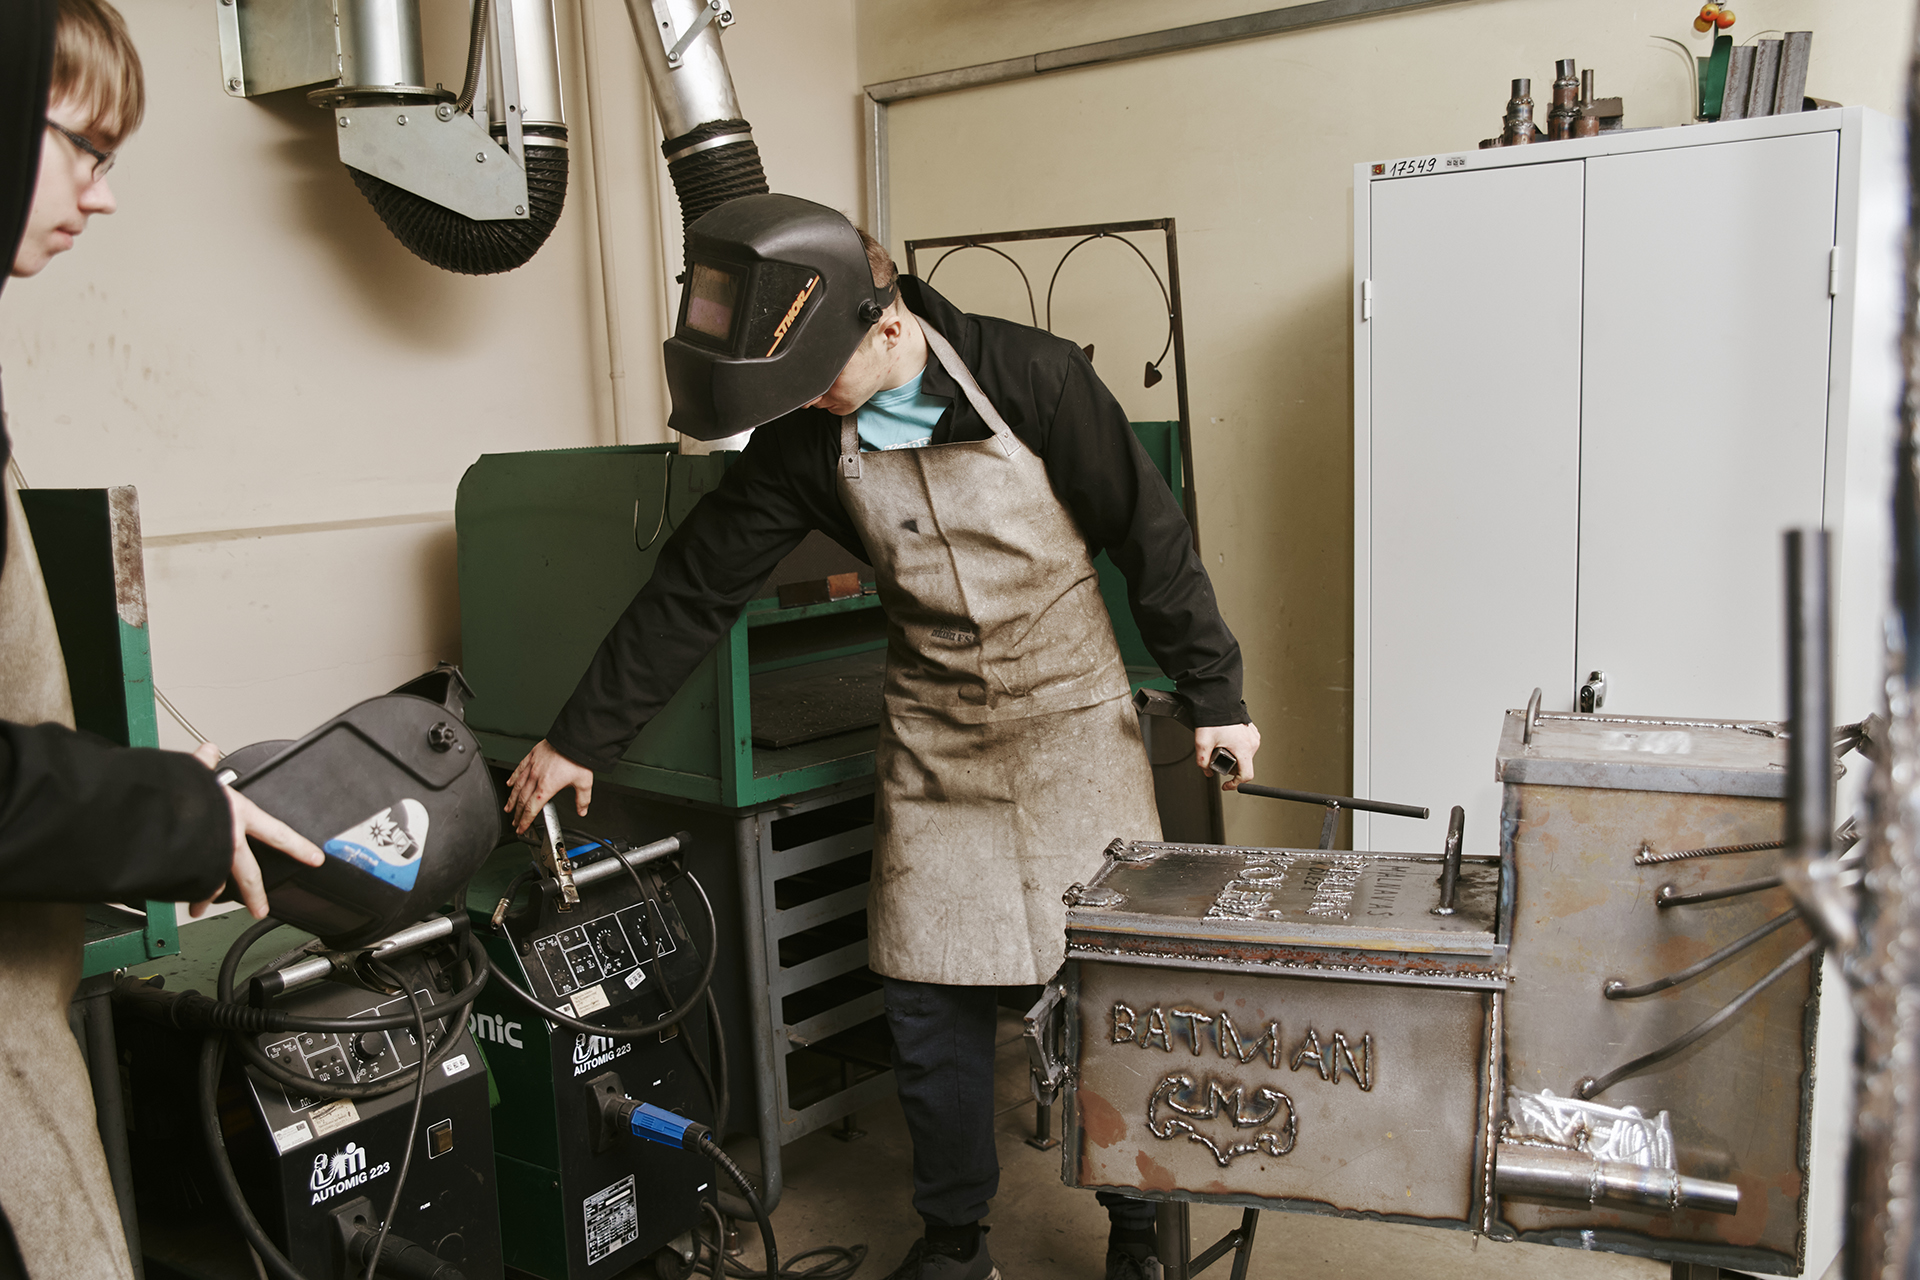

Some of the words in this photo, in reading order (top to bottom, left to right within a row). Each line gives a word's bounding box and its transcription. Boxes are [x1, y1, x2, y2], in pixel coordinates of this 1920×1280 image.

[1389, 157, 1437, 177] 17549
[572, 1050, 616, 1077] AUTOMIG
[615, 1042, 632, 1058] 223
[1112, 1003, 1373, 1092] BATMAN
[311, 1171, 368, 1206] AUTOMIG
[369, 1161, 391, 1180] 223
